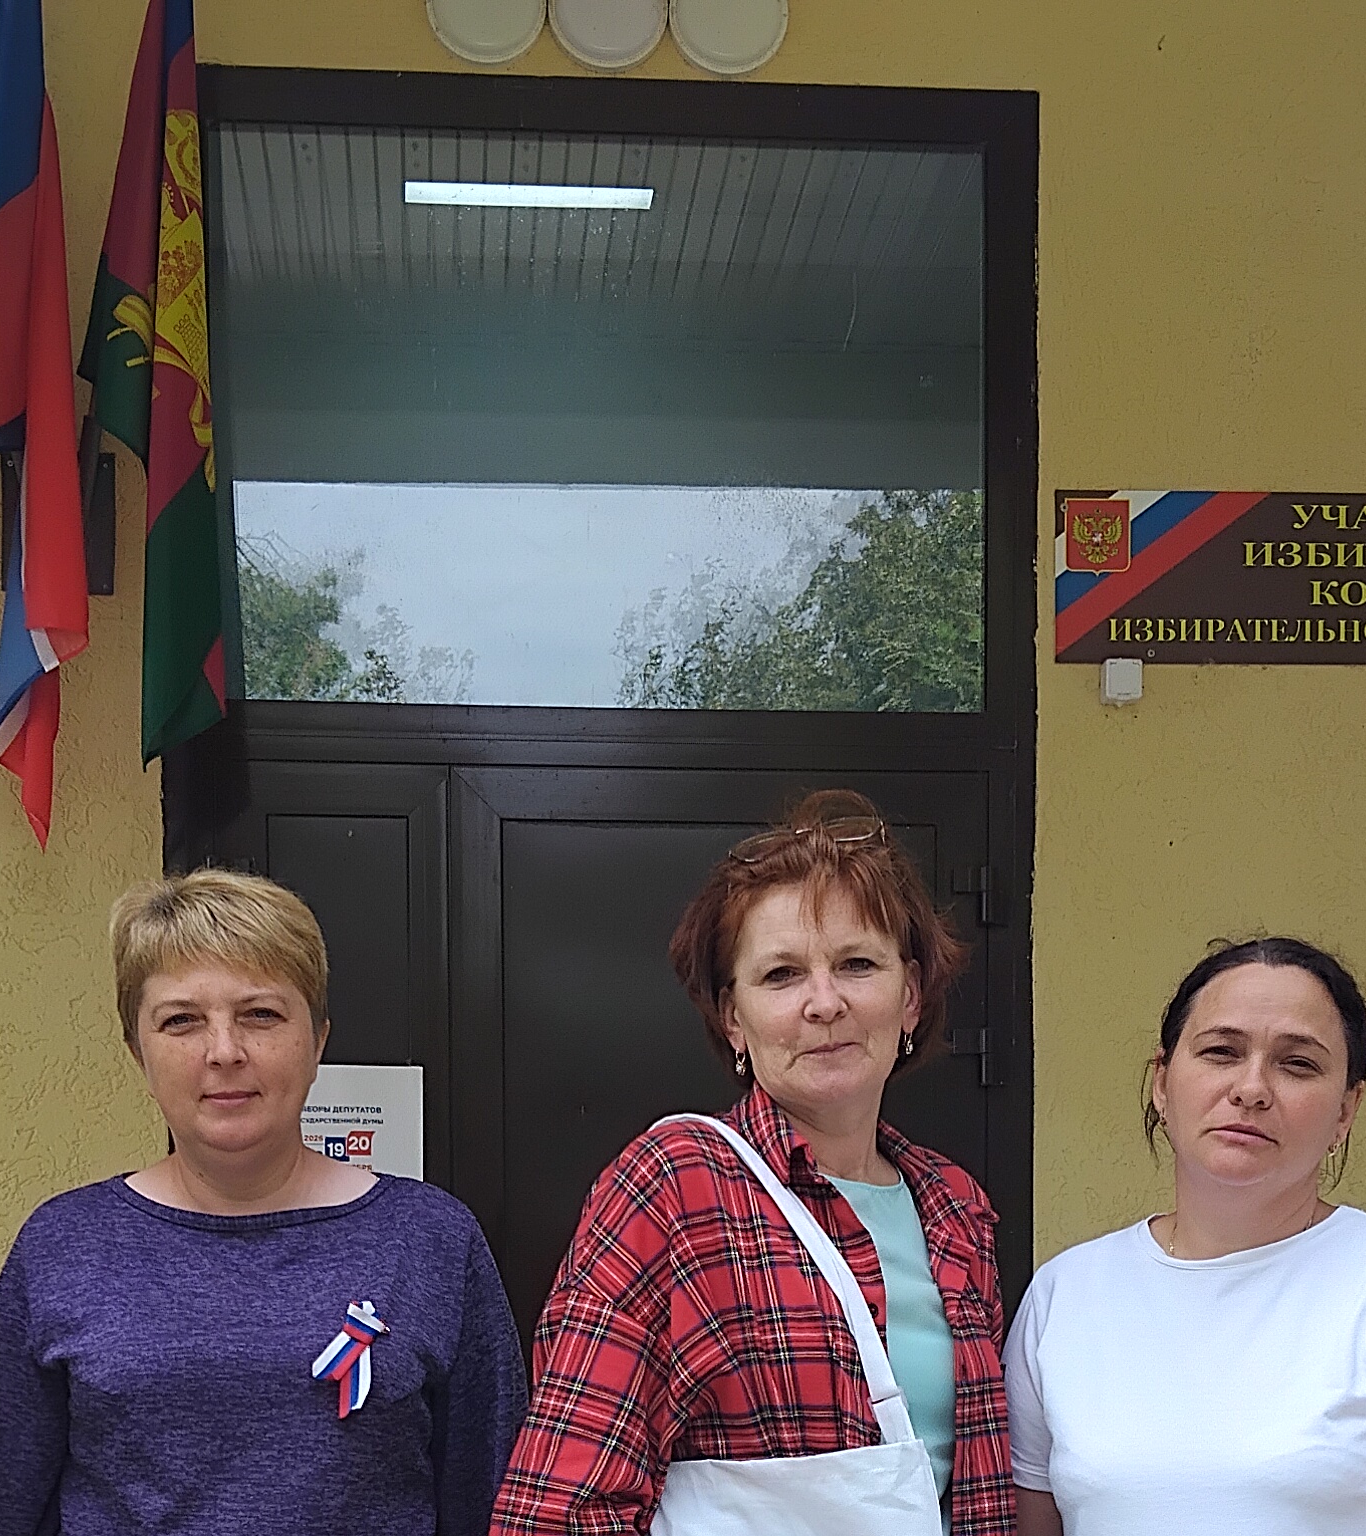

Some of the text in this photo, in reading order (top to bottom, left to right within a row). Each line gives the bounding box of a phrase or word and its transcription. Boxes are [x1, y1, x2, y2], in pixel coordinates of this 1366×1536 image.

[332, 1106, 382, 1114] ДЕПУТАТОВ
[326, 1136, 370, 1157] 19 20
